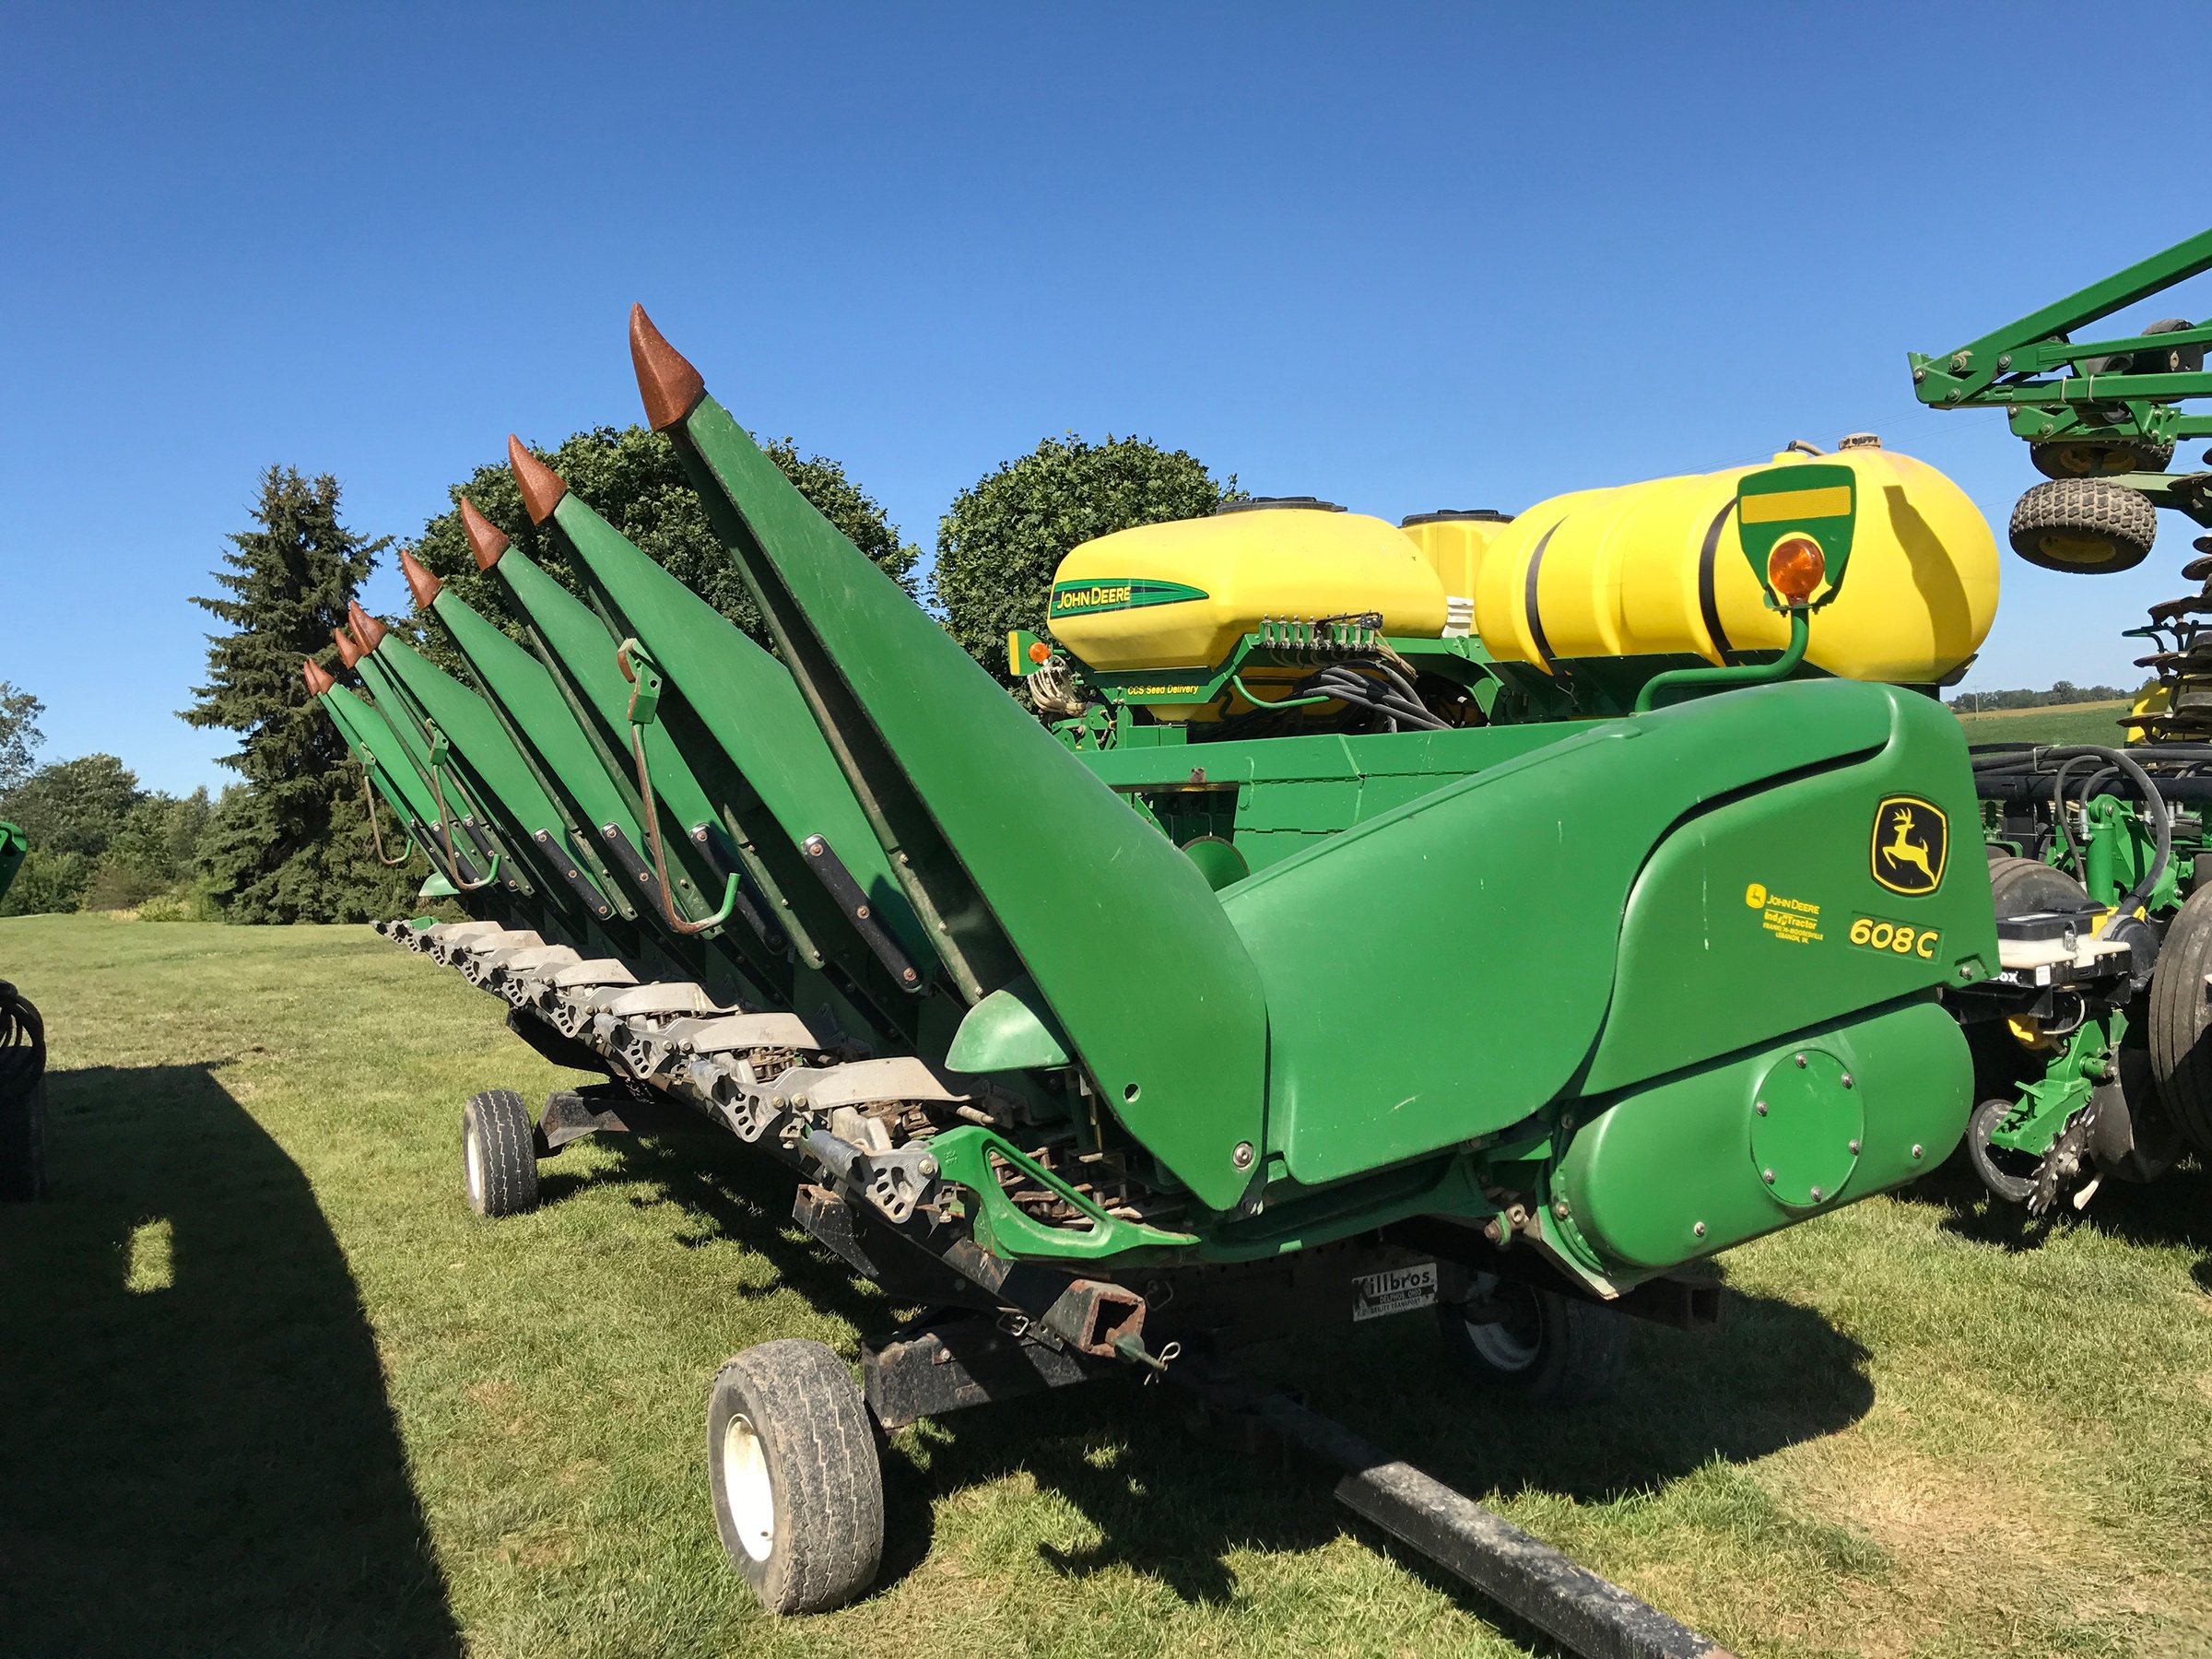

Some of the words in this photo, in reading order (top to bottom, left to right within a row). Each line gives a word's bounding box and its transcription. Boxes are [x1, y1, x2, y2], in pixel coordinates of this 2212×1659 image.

[1057, 589, 1090, 610] JOHN
[1091, 587, 1131, 606] DEERE
[1127, 685, 1145, 696] CCS
[1146, 684, 1166, 695] Seed
[1167, 684, 1199, 696] Delivery
[1767, 895, 1791, 909] JOHN
[1792, 900, 1820, 914] DEERE
[1786, 916, 1818, 930] Tractor
[1352, 1271, 1430, 1313] Killbros
